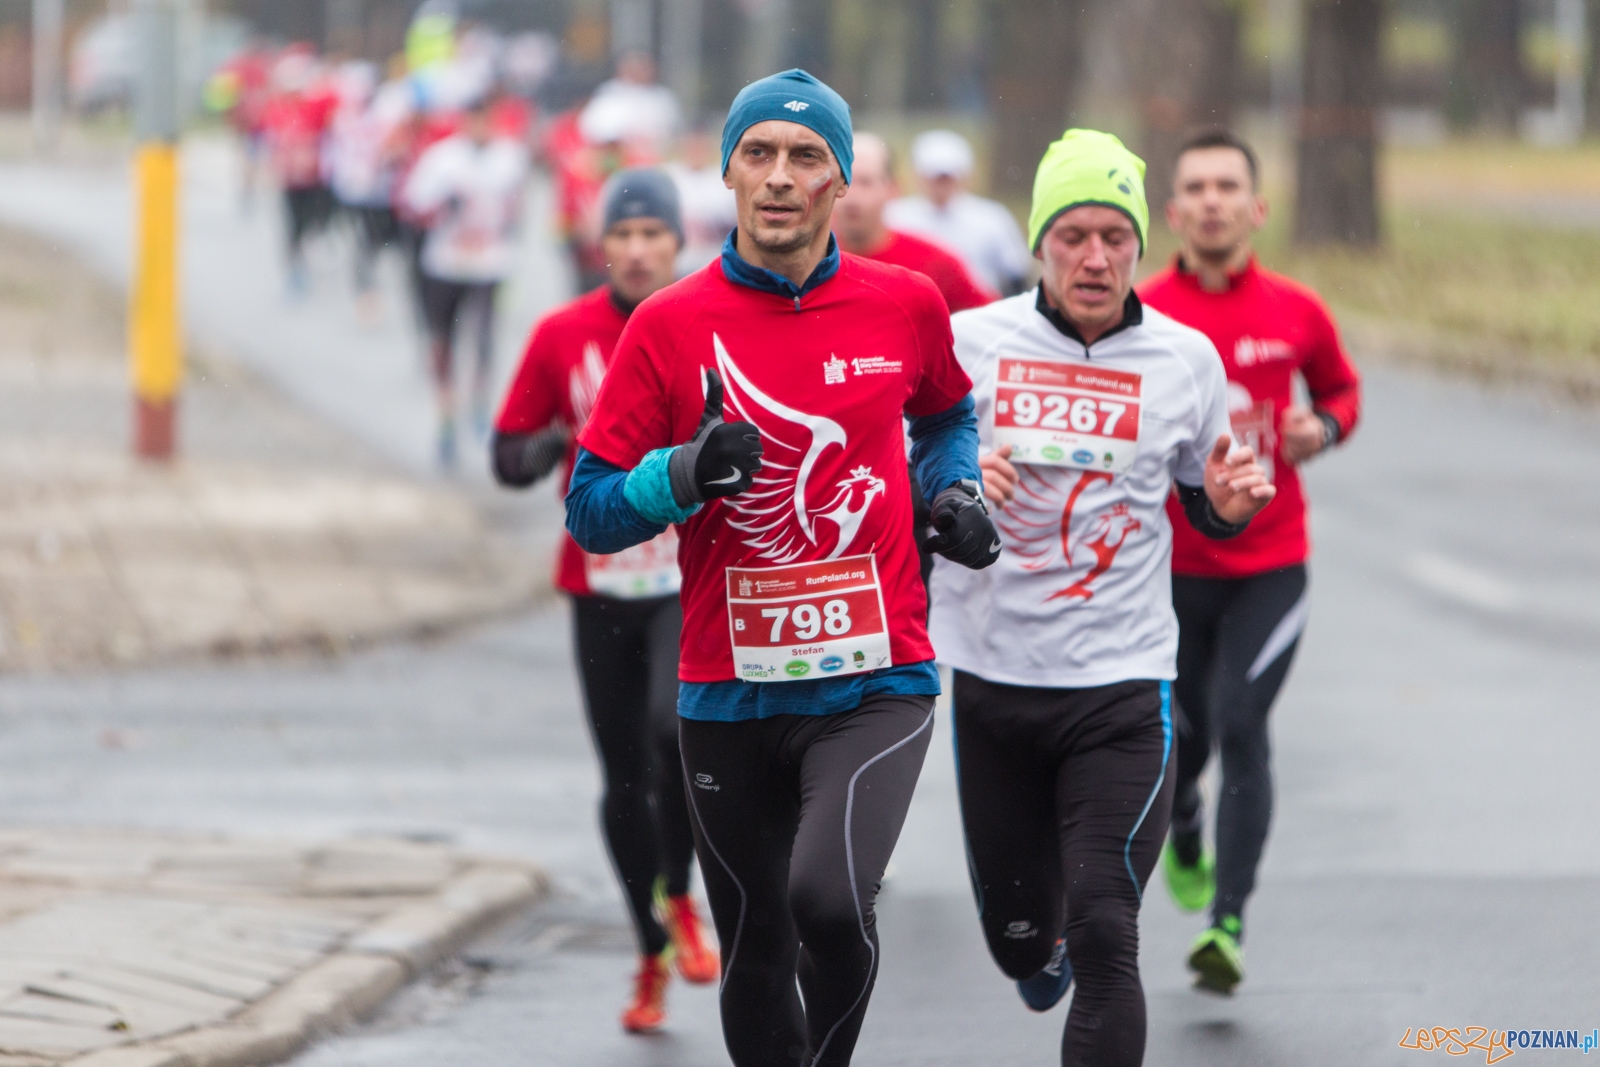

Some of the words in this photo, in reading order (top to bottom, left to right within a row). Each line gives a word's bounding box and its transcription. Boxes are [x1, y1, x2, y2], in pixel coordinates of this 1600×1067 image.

[783, 100, 810, 112] 4F
[1013, 391, 1127, 436] 9267
[805, 570, 866, 586] RunPoland.org
[734, 618, 746, 631] B
[760, 599, 852, 643] 798
[791, 646, 825, 657] Stefan
[742, 663, 764, 671] GRUPA
[743, 670, 768, 678] LUXMED
